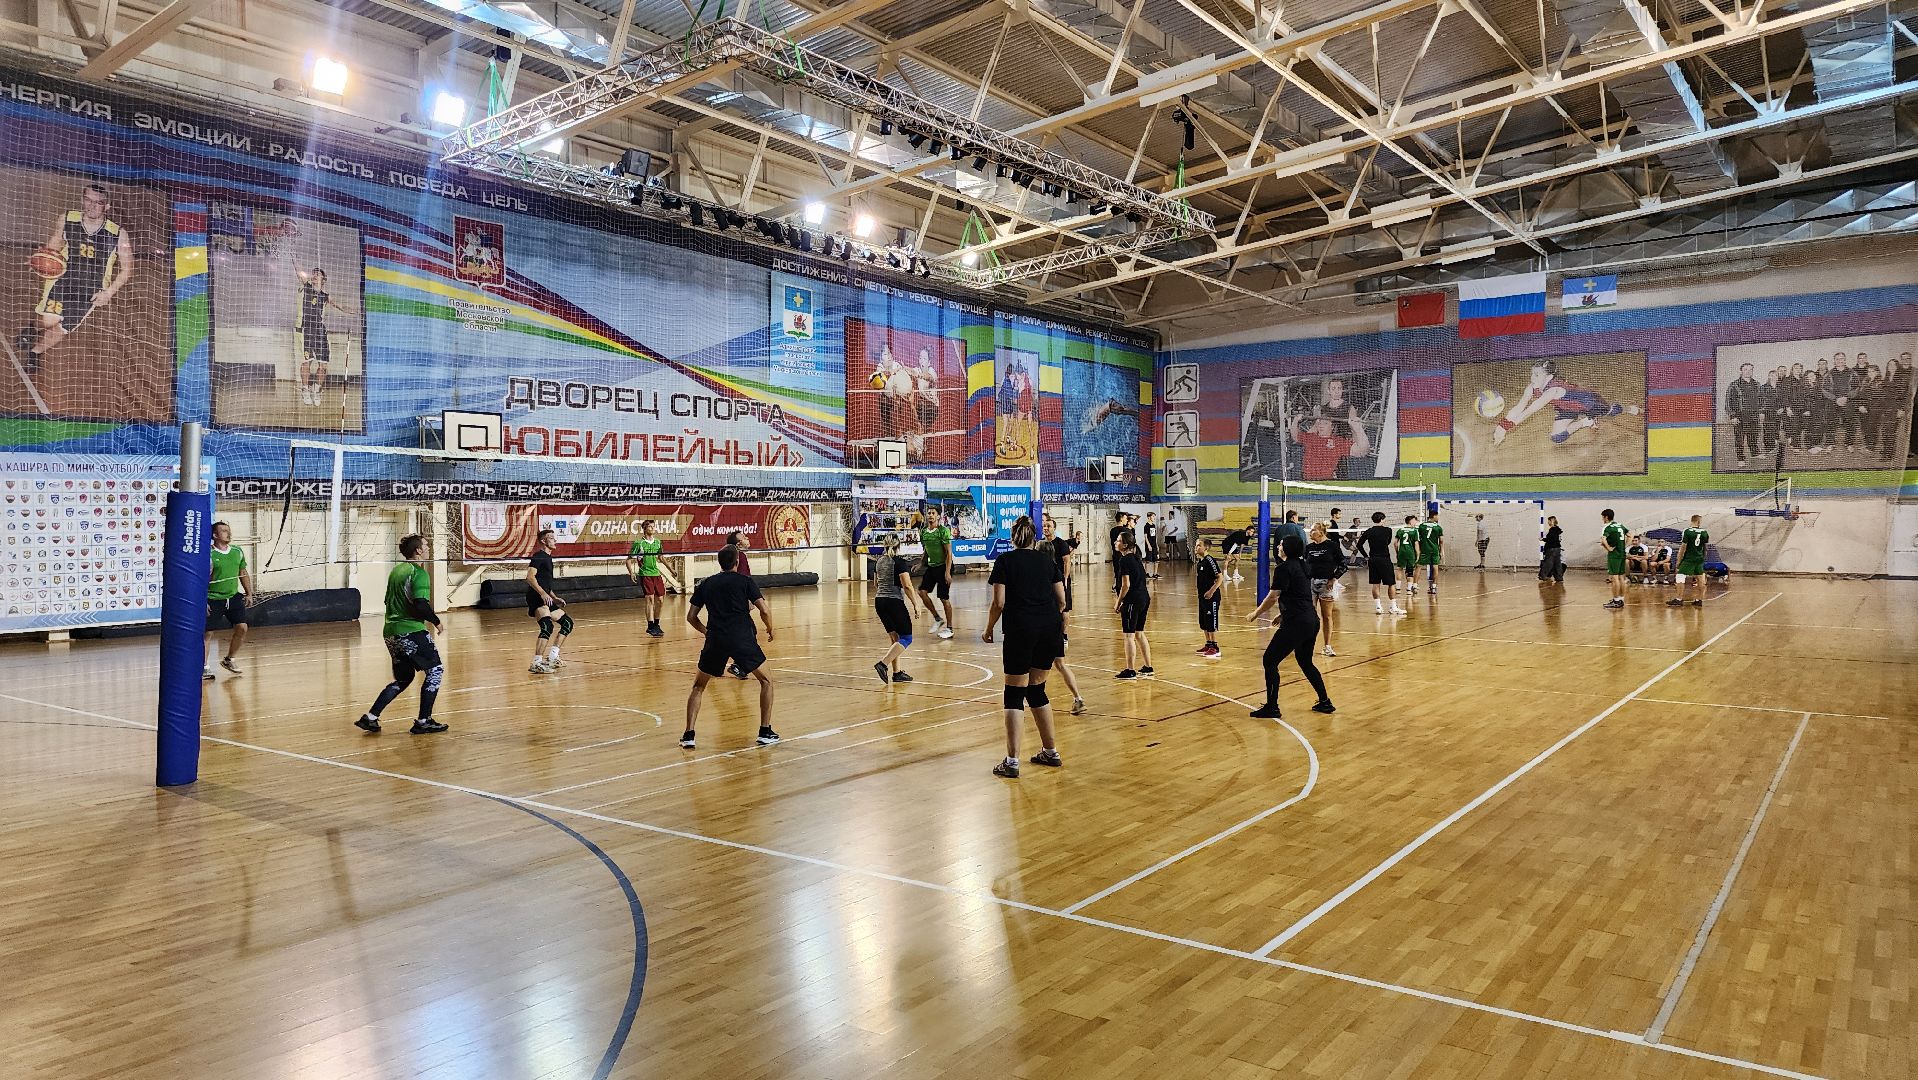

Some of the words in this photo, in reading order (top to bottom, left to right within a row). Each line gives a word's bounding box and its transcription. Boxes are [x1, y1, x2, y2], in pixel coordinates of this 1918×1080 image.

[0, 81, 111, 120] НЕРГИЯ
[134, 112, 250, 151] ЭМОЦИИ
[269, 143, 374, 178] РАДОСТЬ
[389, 170, 468, 199] ПОБЕДА
[482, 191, 528, 211] ЦЕЛЬ
[773, 258, 847, 284] ДОСТИЖЕНИЯ
[854, 278, 903, 297] СМЕЛОСТЬ
[909, 293, 943, 306] РЕКОРД
[949, 301, 988, 315] БУДУЩЕЕ
[994, 310, 1017, 322] СПОРТ
[1022, 316, 1041, 326] СИЛА
[1046, 321, 1081, 333] ДИНАМИКА
[1086, 329, 1107, 340] РЕКОРД
[449, 299, 511, 314] Правительство
[456, 310, 504, 323] Московской
[464, 322, 497, 332] области
[505, 377, 660, 421] ДВОРЕЦ
[670, 393, 786, 425] СПОРТА
[6, 462, 49, 472] КАШИРА
[52, 463, 64, 473] ПО
[67, 463, 145, 473] МИНИ-ФУТБОЛУ
[392, 483, 496, 495] СМЕЛОСТЬ
[508, 484, 573, 498] РЕКОРД
[589, 486, 661, 498] БУДУЩЕЕ
[674, 487, 716, 497] СПОРТ
[724, 488, 758, 499] СИЛА
[765, 489, 829, 501] ДИНАМИКА
[183, 509, 194, 553] Schelde
[591, 520, 628, 537] ОДНА
[630, 519, 680, 536] САНА,
[692, 523, 715, 535] одна
[1426, 527, 1433, 539] 7
[1617, 527, 1625, 541] 3
[1402, 532, 1410, 545] 2
